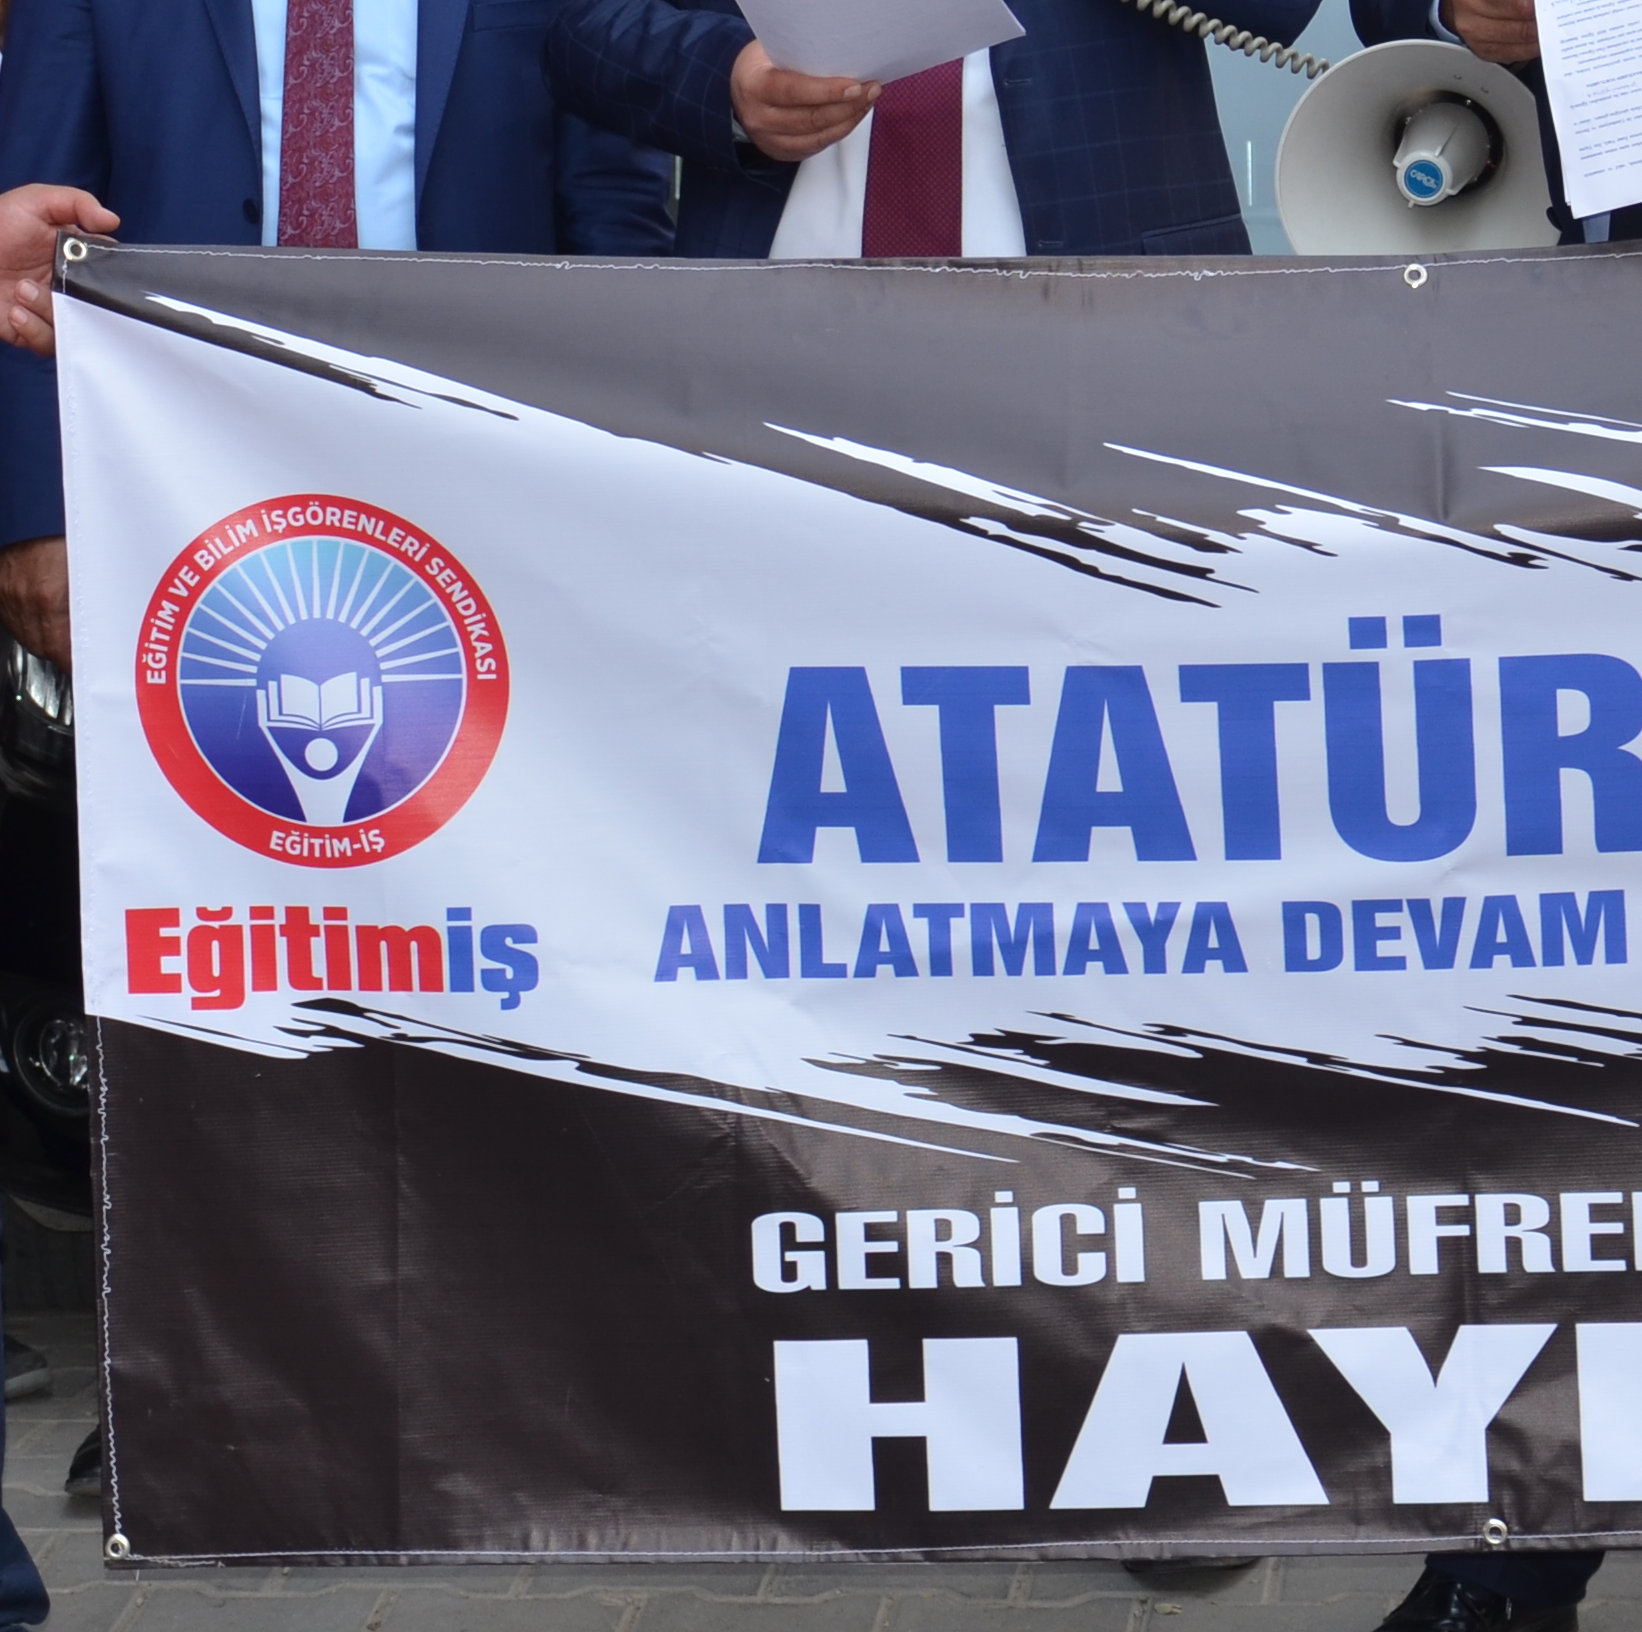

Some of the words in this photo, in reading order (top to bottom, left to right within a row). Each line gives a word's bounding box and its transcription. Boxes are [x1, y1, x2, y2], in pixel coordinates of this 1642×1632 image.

[141, 599, 181, 685] EĞİTİM
[168, 564, 196, 599] VE
[192, 519, 260, 571] BİLİM
[261, 500, 433, 564] İŞGÖRENLERİ
[423, 555, 497, 682] SENDİKASI
[268, 828, 387, 859] EĞİTİM-İŞ
[124, 905, 540, 1011] Eğitimiş
[653, 901, 1249, 983] ANLATMAYA
[1281, 889, 1628, 973] DEVAM
[750, 1186, 1145, 1294] GERİCİ
